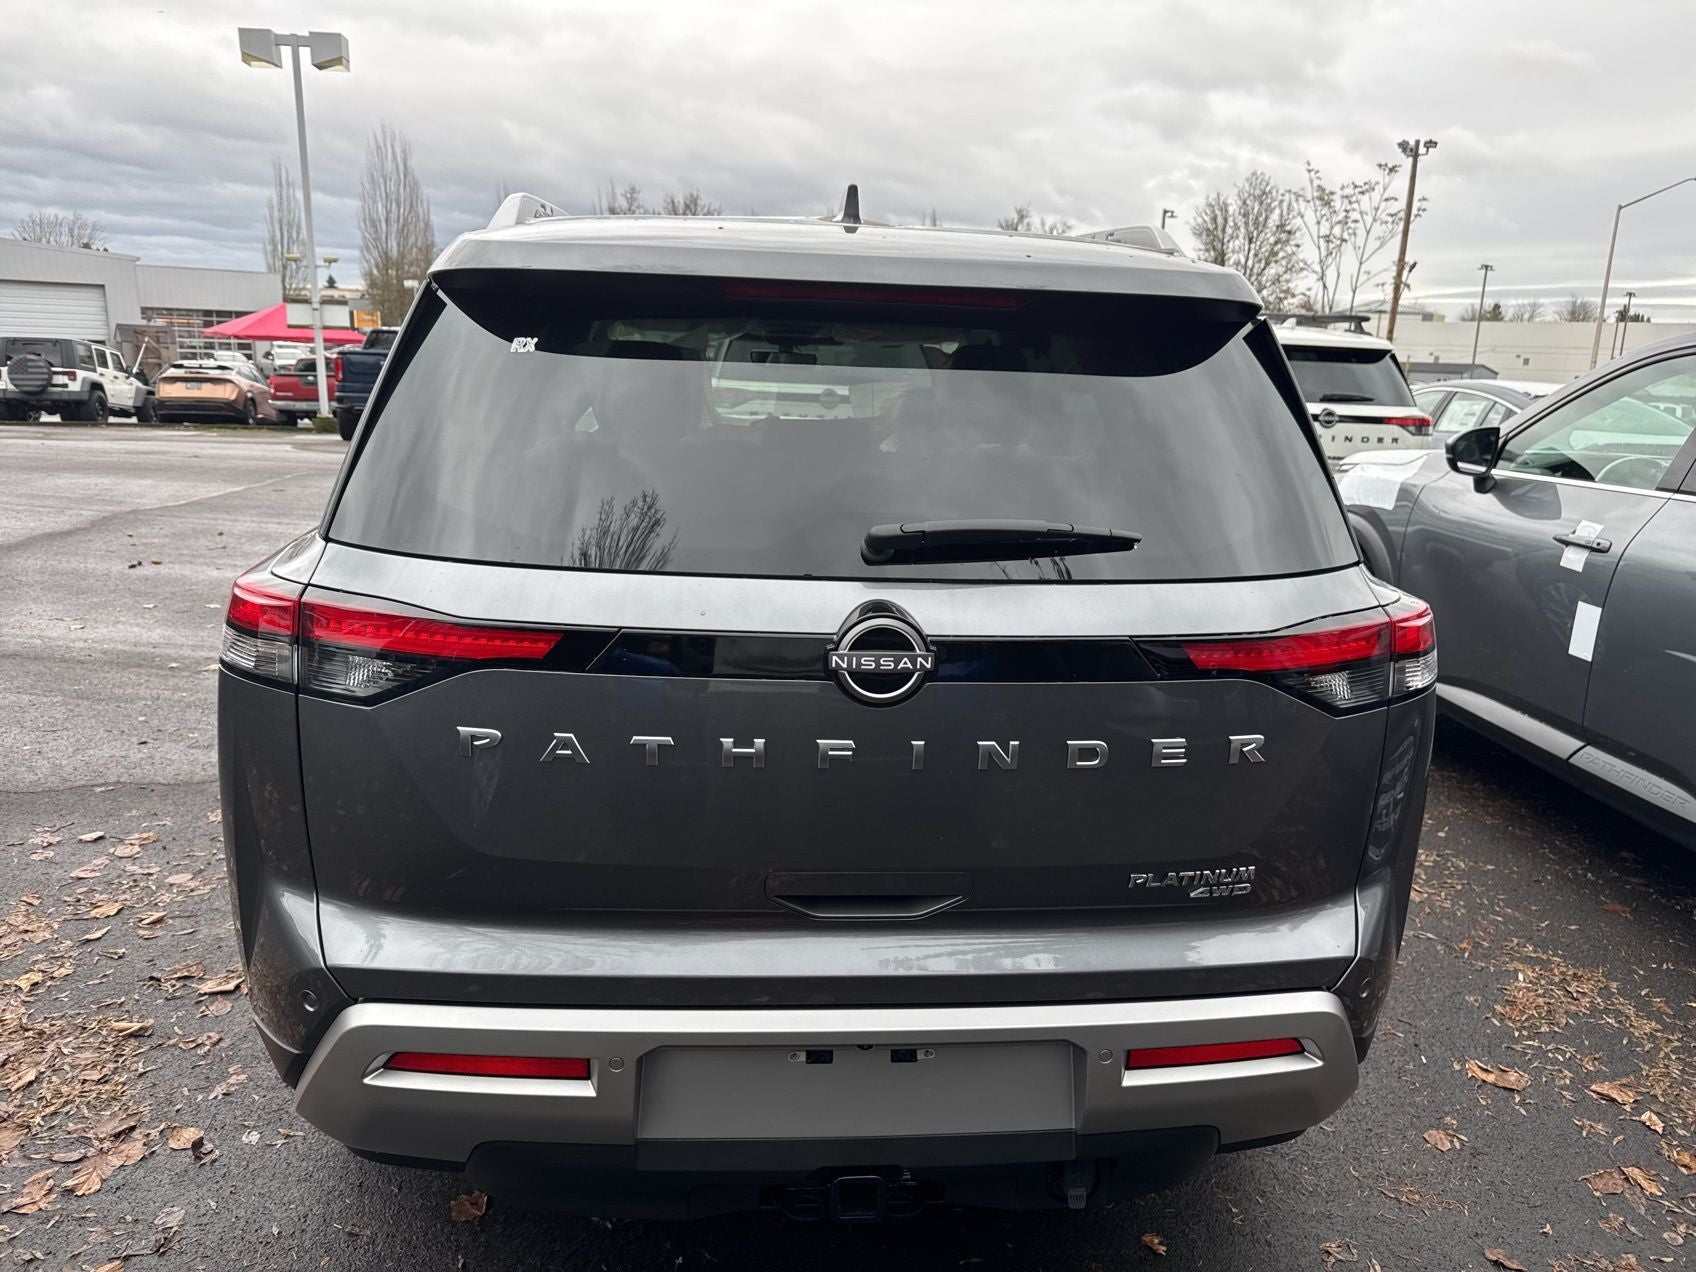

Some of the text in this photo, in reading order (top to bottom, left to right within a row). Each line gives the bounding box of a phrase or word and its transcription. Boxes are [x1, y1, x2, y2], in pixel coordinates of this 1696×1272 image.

[1319, 434, 1399, 444] INDER
[832, 655, 932, 670] NISSAN
[456, 726, 1266, 770] PATHFINDER
[1579, 751, 1691, 810] PATHFINDER
[1128, 865, 1256, 889] PLATINUM
[1189, 883, 1253, 898] 4WD
